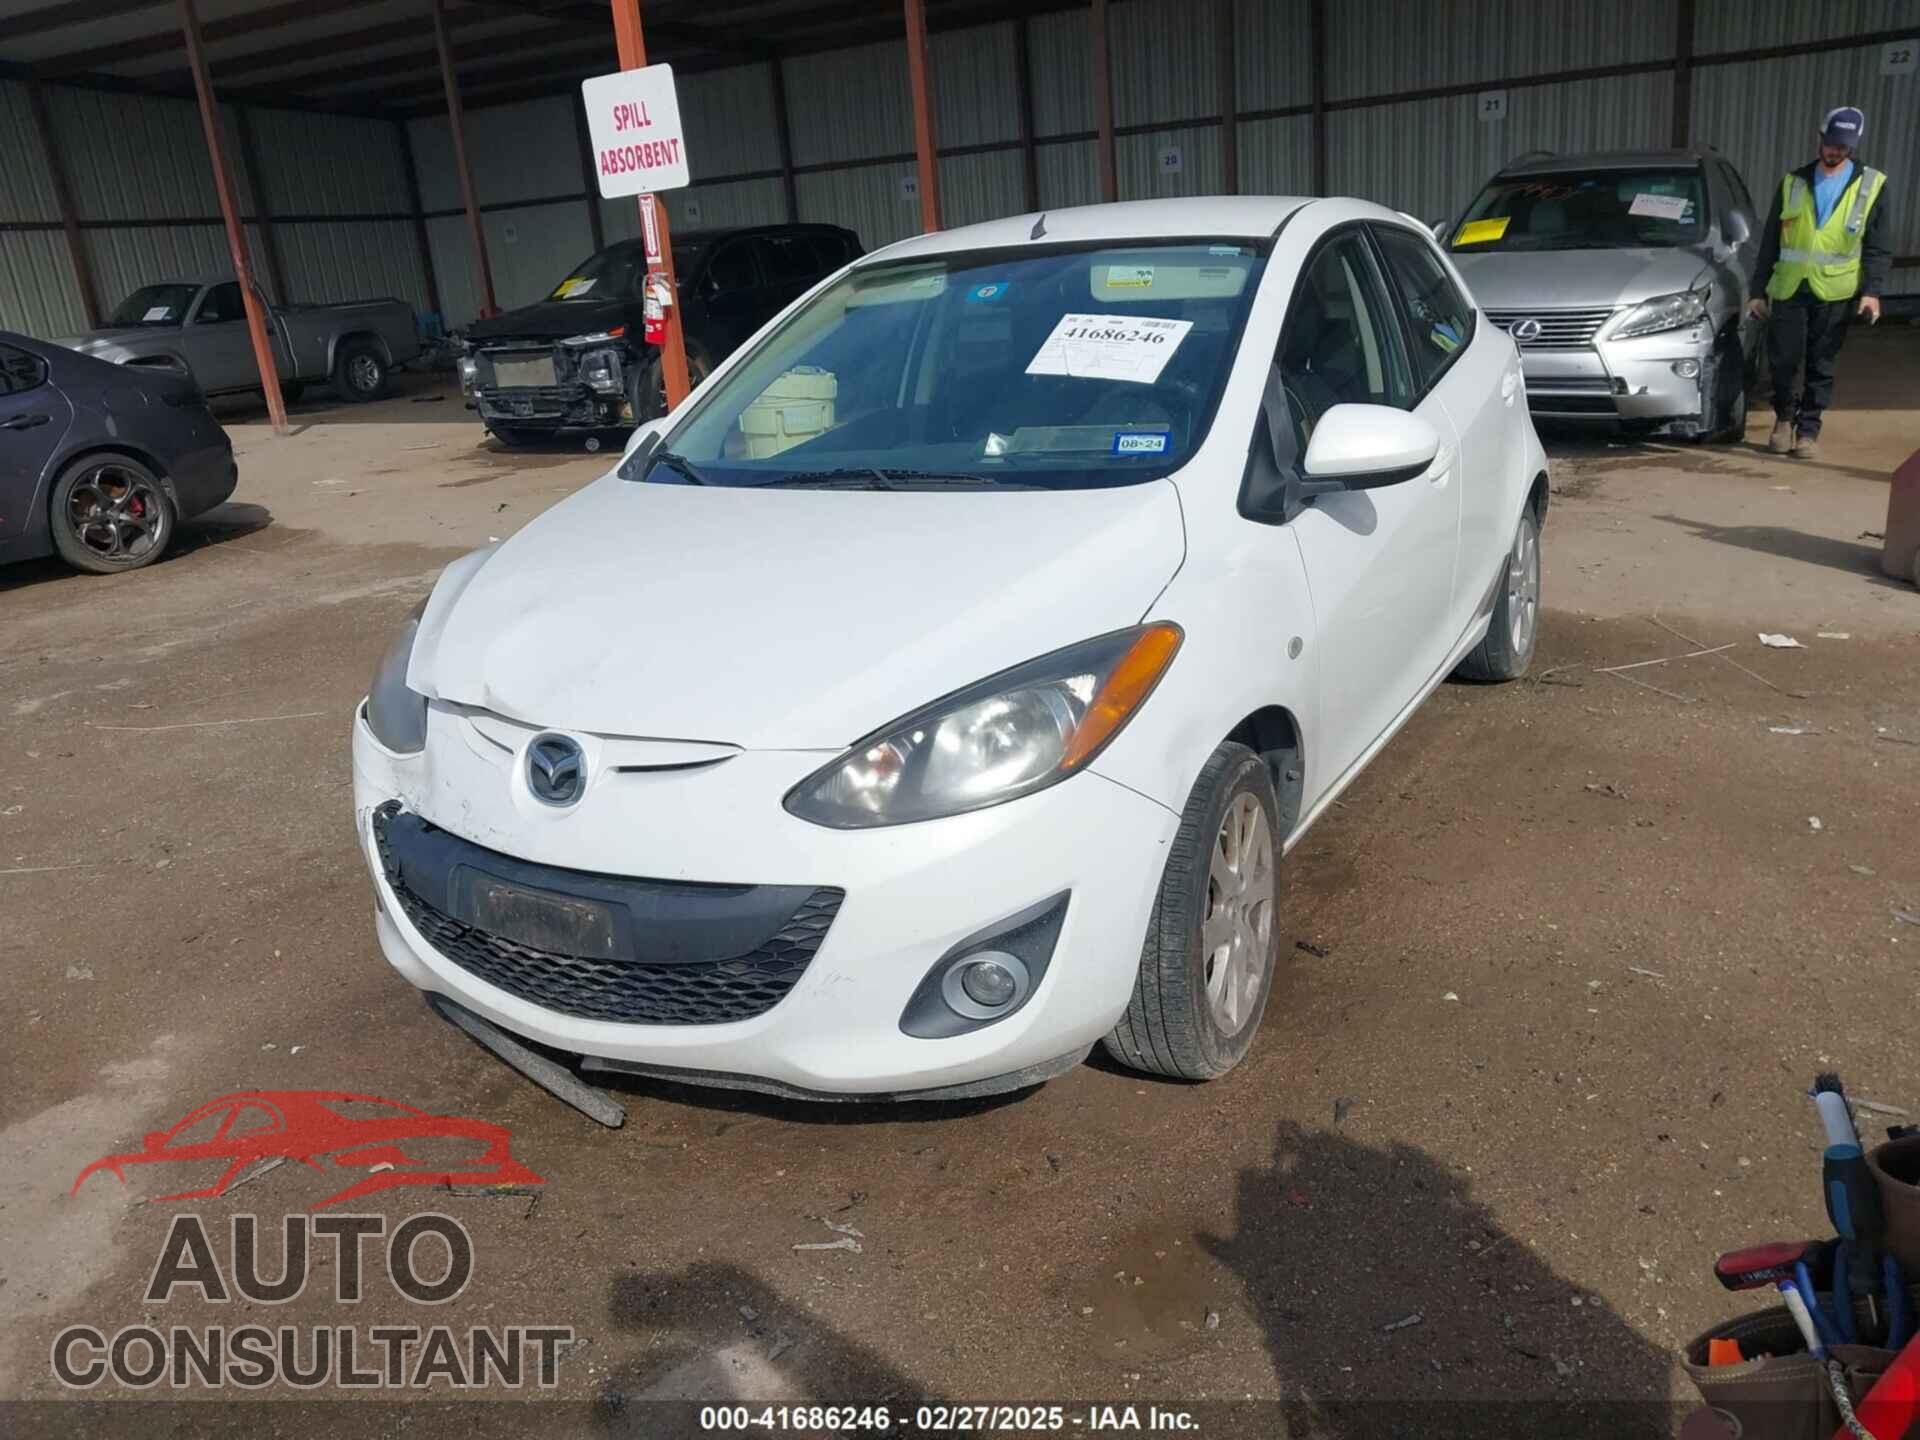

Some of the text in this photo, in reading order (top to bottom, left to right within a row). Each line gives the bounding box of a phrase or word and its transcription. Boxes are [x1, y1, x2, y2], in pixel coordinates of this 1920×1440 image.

[1888, 50, 1911, 65] 22
[1485, 99, 1500, 111] 21
[613, 100, 652, 132] SPILL
[600, 138, 679, 176] ABSORBENT
[1164, 154, 1178, 166] 20
[1063, 326, 1165, 345] 41686246
[1121, 438, 1163, 449] 08-24
